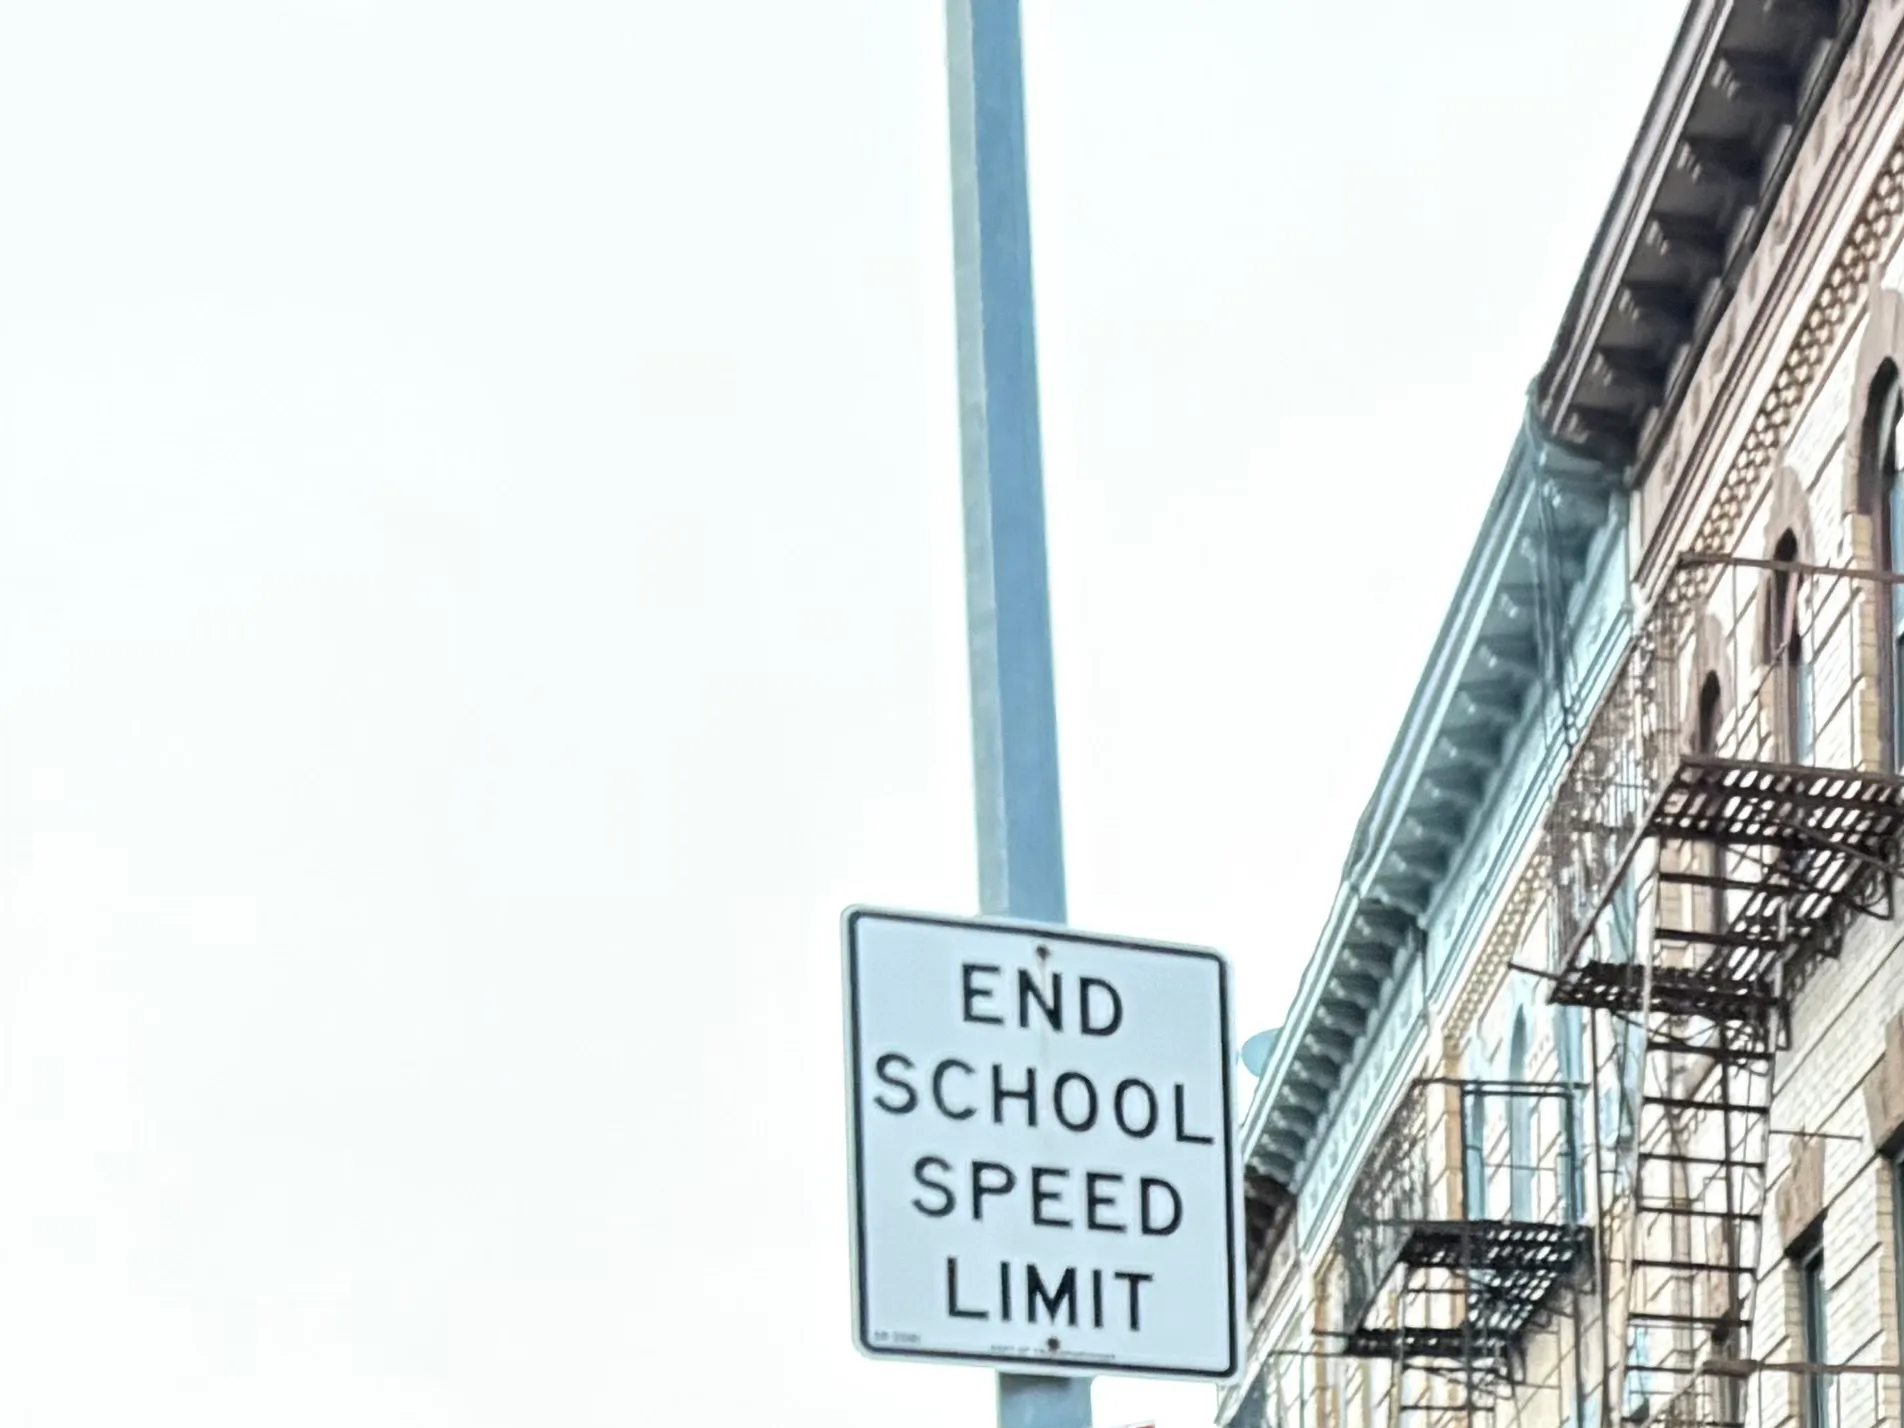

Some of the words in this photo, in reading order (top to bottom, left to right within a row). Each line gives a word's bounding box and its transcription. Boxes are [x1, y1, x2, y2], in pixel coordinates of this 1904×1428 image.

[962, 962, 1124, 1037] END
[873, 1052, 1215, 1145] SCHOOL
[911, 1155, 1184, 1236] SPEED
[946, 1256, 1154, 1333] LIMIT
